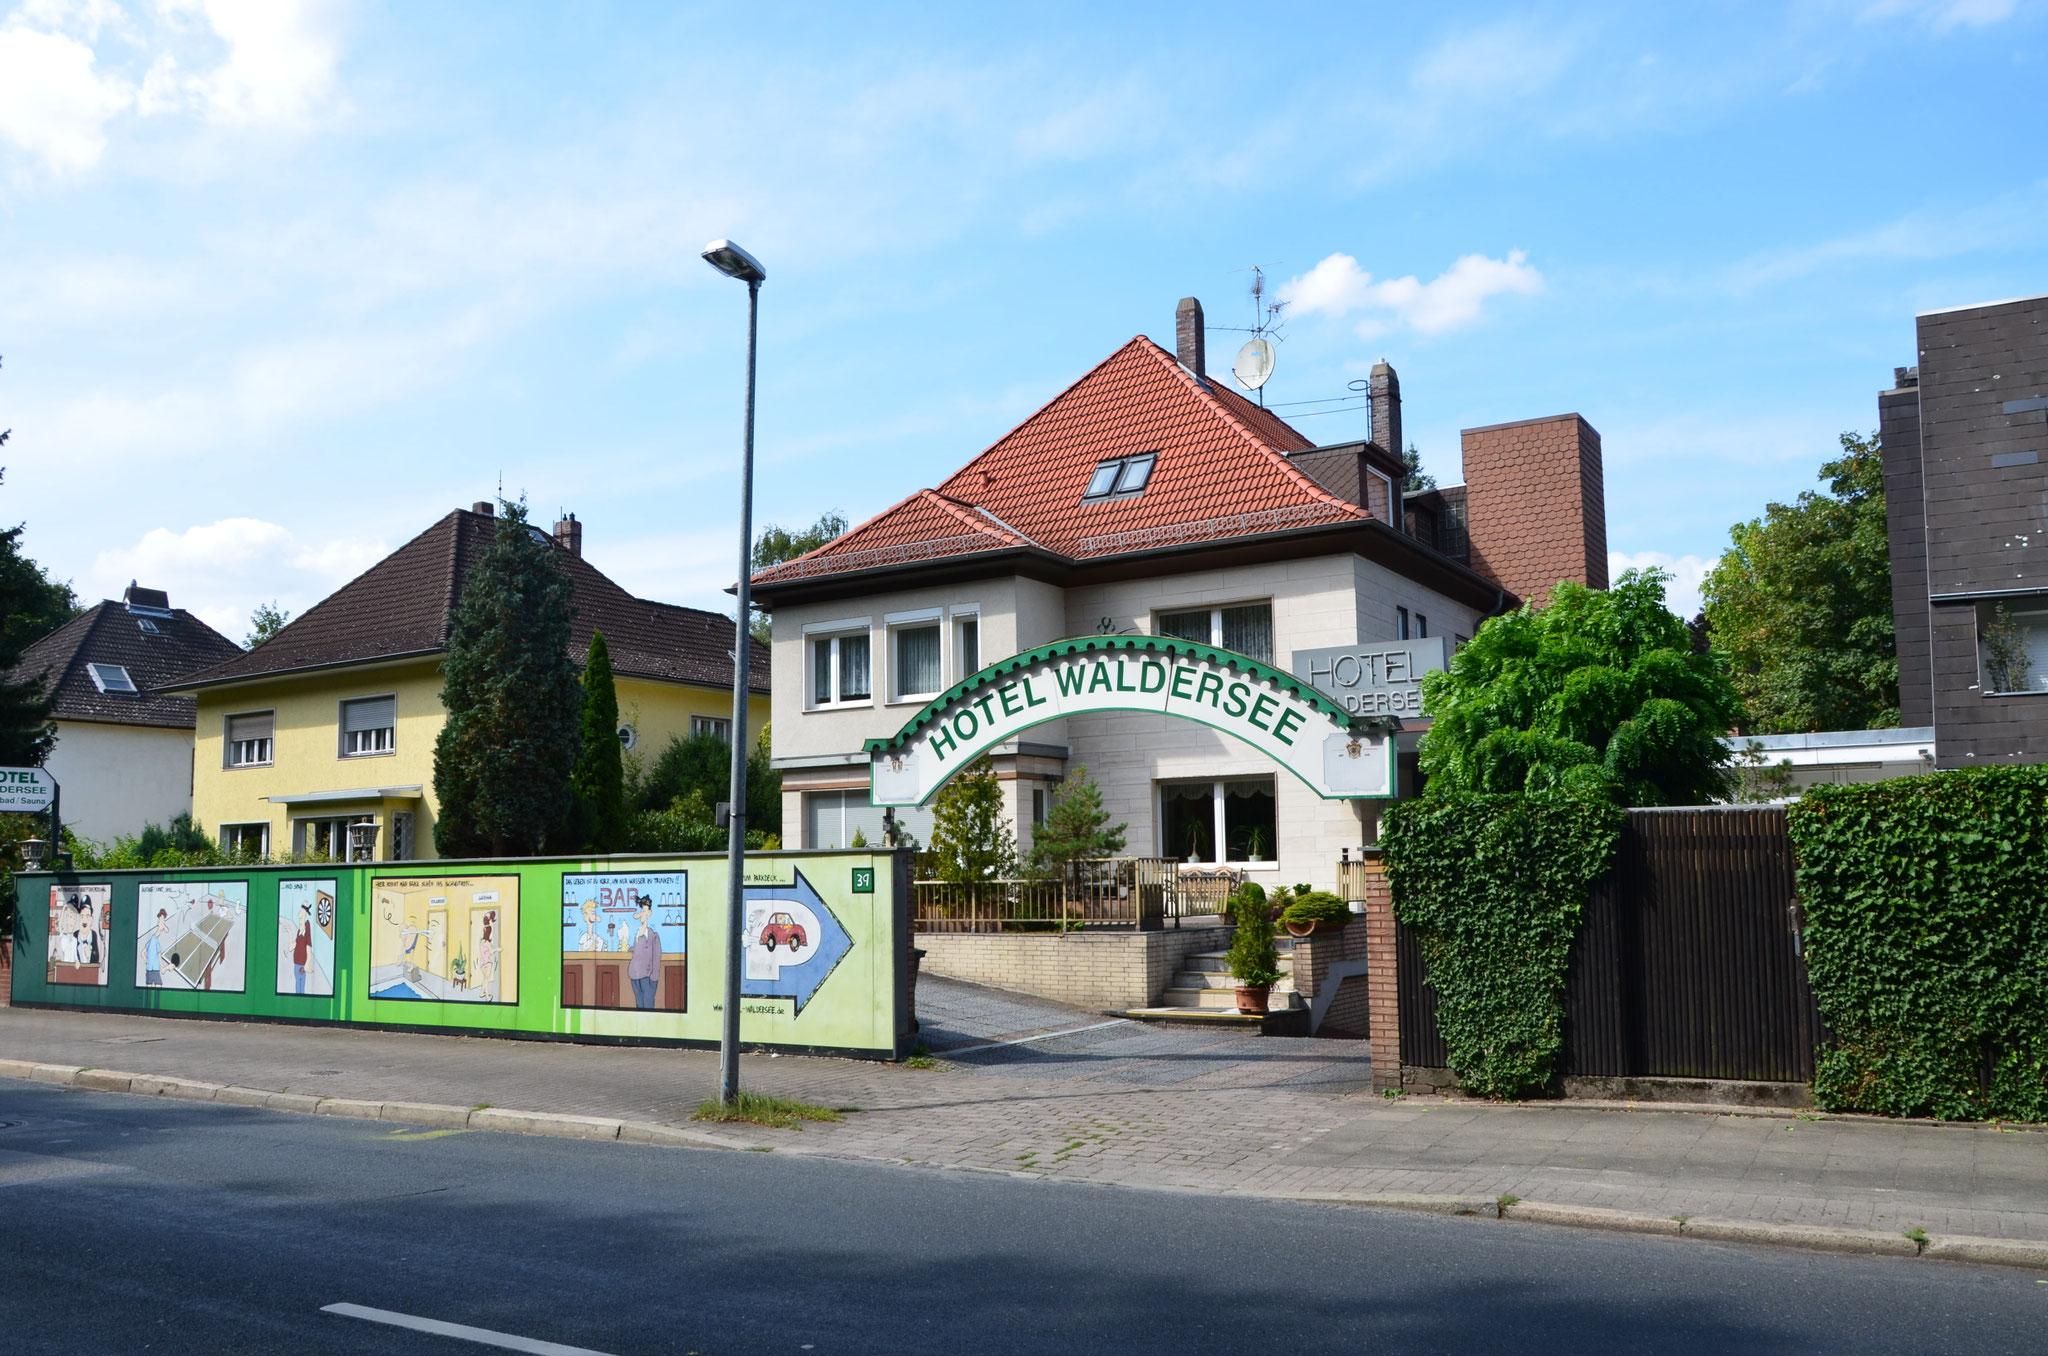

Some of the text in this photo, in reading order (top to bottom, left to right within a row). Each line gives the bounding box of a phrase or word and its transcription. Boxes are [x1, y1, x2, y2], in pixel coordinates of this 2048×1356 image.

[1308, 650, 1423, 689] HOTEL
[1334, 689, 1425, 713] DERSE
[929, 660, 1307, 760] HOTEL WALDERSEE
[0, 785, 47, 795] DERSEE
[21, 797, 46, 805] Sauna
[629, 877, 646, 885] WASSER
[743, 874, 751, 882] UM
[856, 873, 869, 887] 39
[600, 888, 639, 907] BAR
